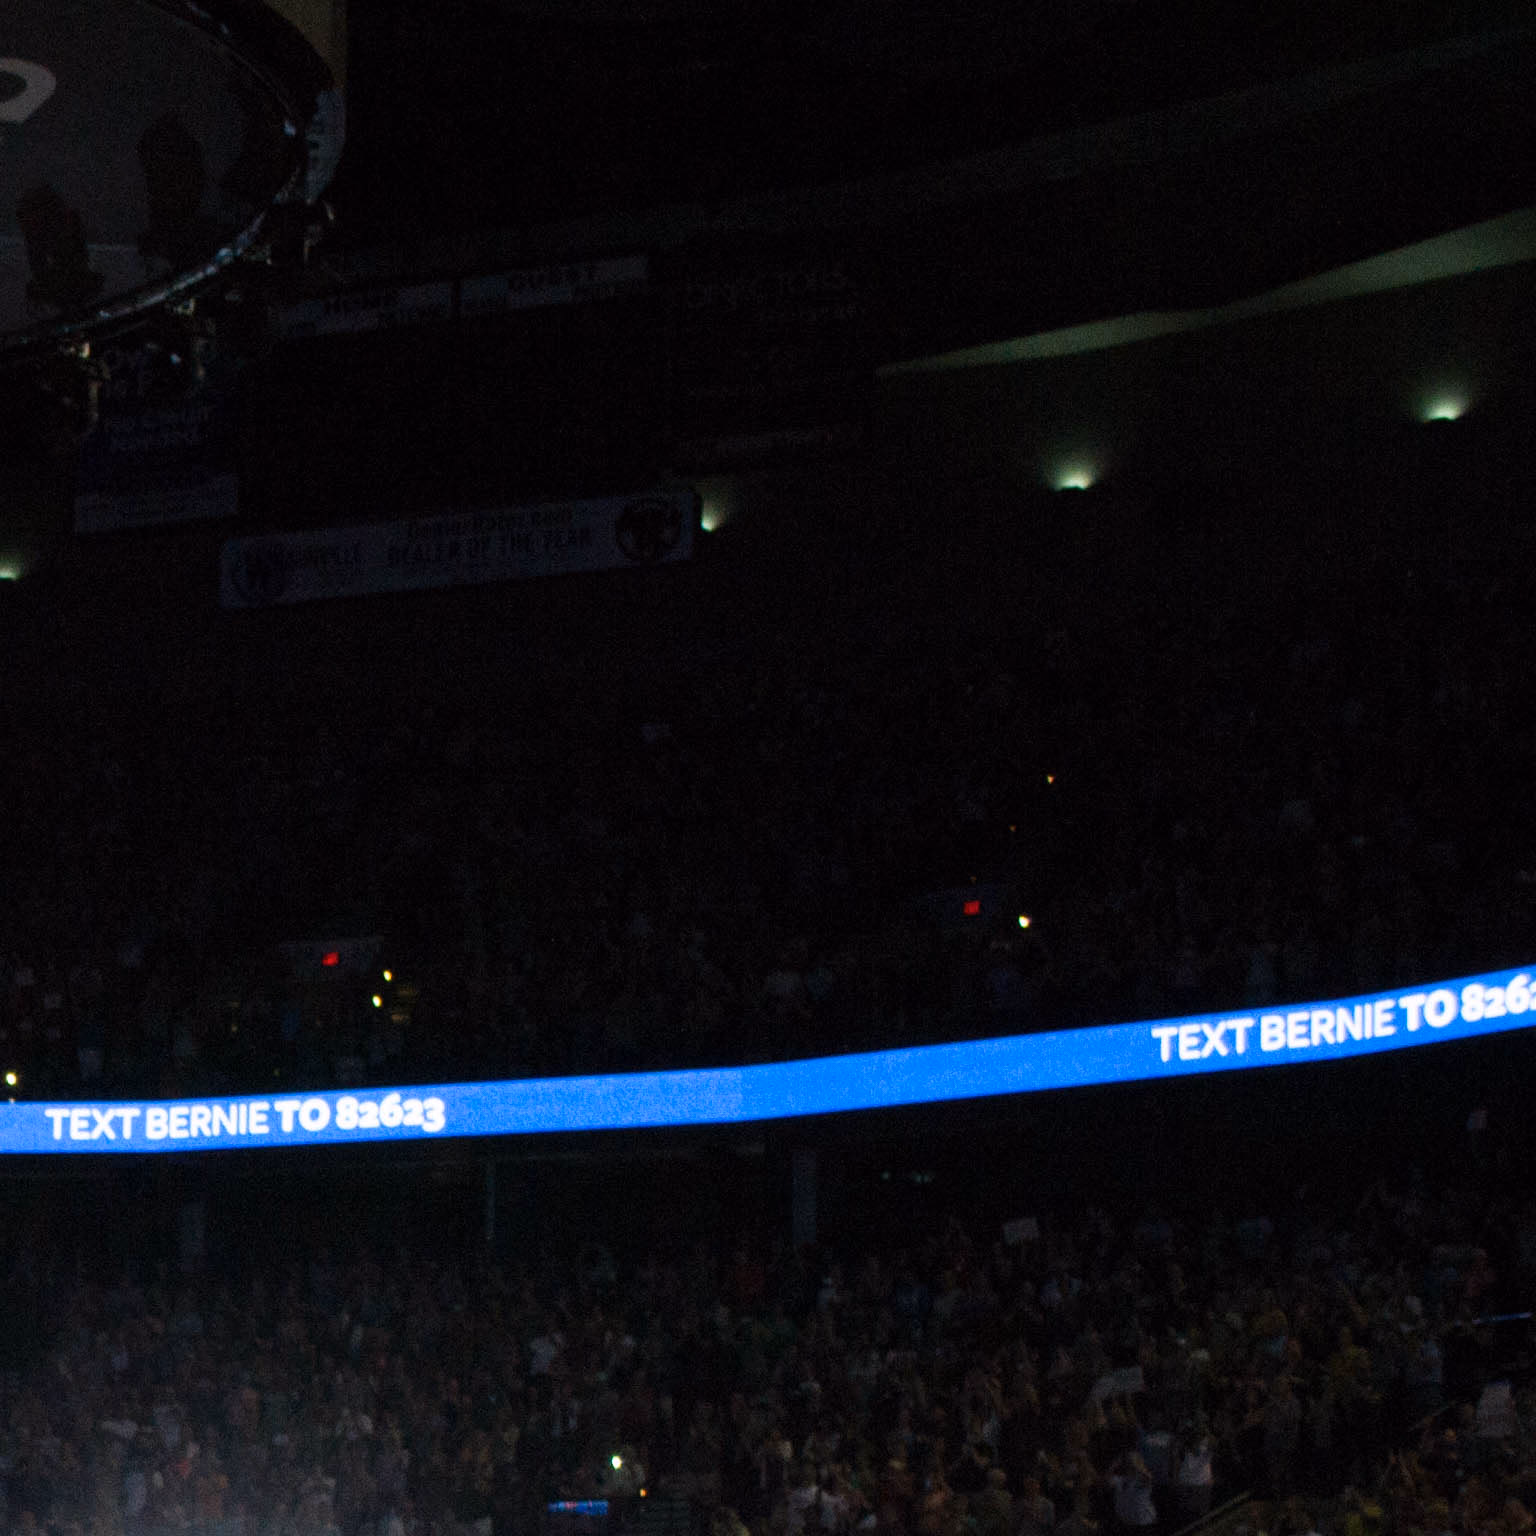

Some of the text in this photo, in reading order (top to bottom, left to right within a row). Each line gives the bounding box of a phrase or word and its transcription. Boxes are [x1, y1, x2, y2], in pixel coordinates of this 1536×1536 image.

[1151, 973, 1536, 1063] TEXT BERNIE TO 826
[44, 1091, 446, 1141] TEXT BERNIE TO 82623
